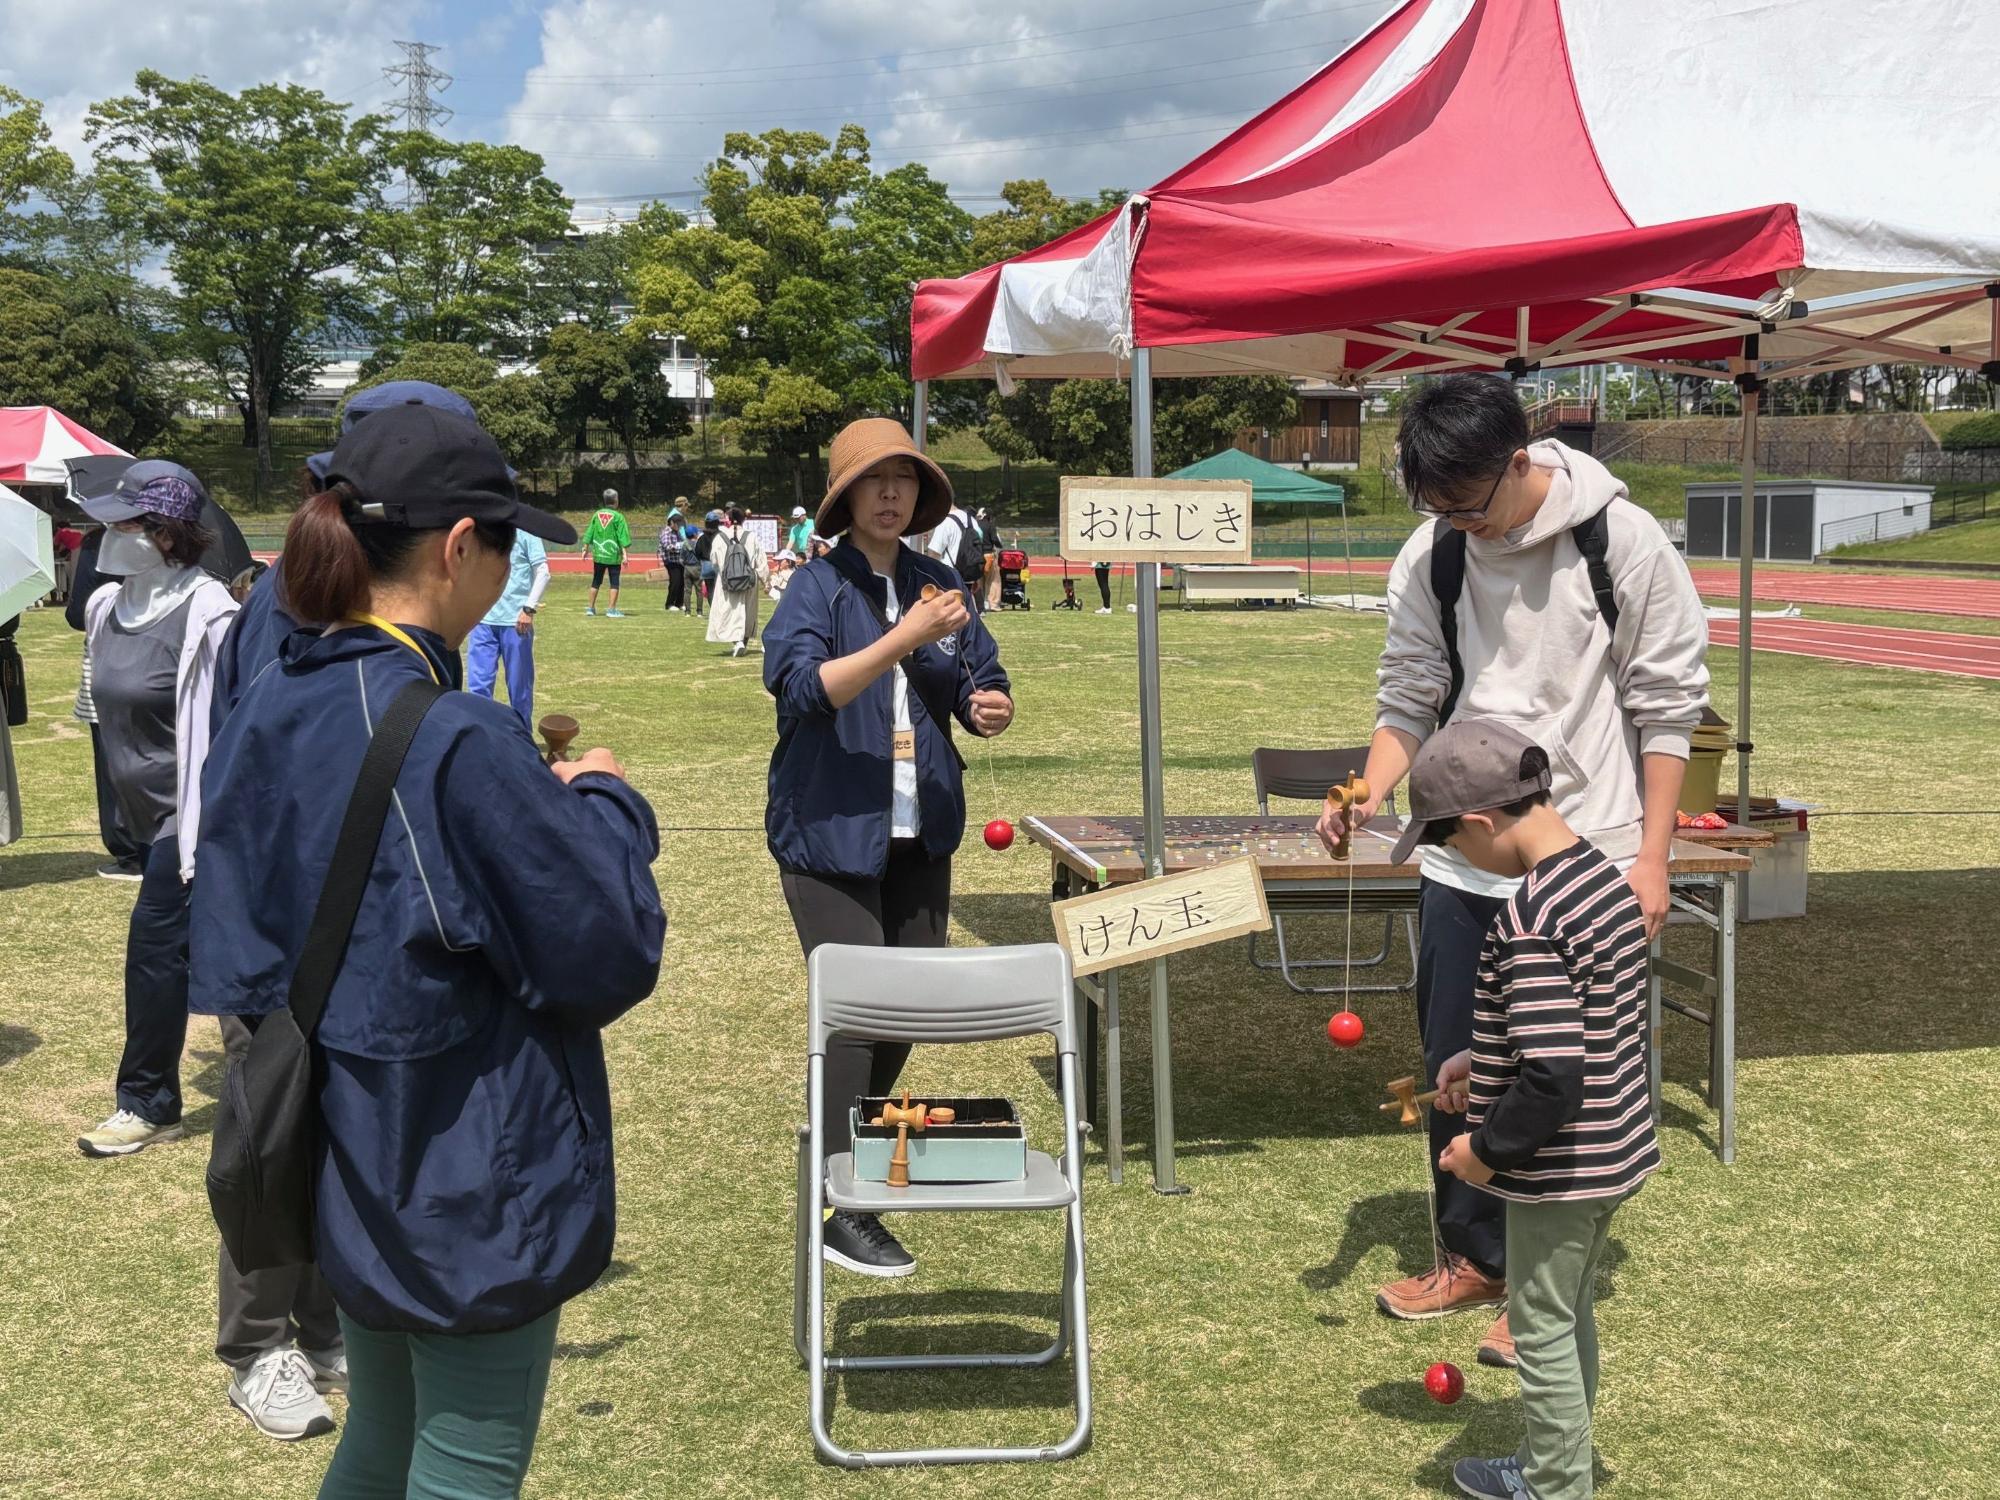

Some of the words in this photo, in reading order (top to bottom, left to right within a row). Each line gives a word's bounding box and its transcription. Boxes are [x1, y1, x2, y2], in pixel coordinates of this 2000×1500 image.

[1080, 502, 1242, 543] おはじき
[1079, 890, 1210, 956] けん玉
